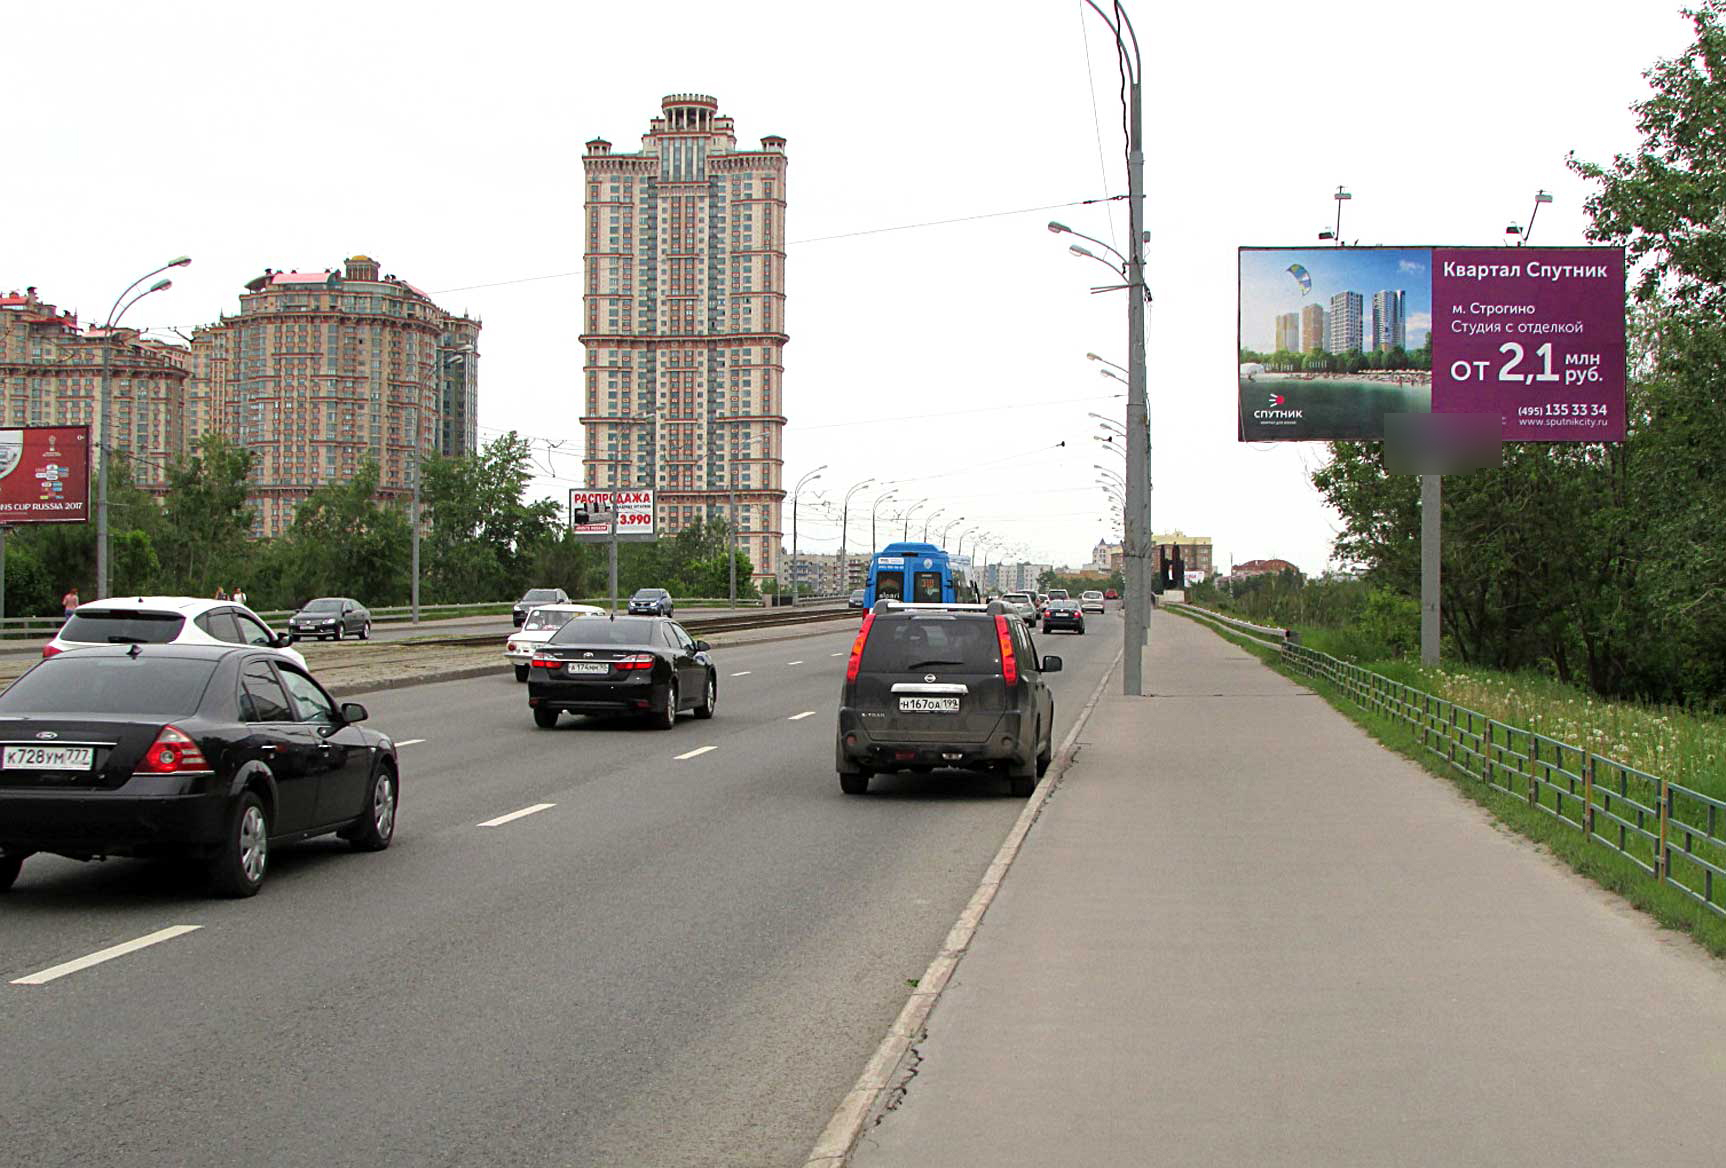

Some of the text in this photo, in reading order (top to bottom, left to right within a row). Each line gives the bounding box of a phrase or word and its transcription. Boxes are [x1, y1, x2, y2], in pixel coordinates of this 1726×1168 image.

[1443, 261, 1608, 280] Квартал Спутник
[1452, 302, 1536, 317] м. Строгино
[1451, 319, 1583, 335] Студия с отделкой
[1450, 342, 1560, 385] от 2,1
[1565, 354, 1601, 366] млн
[1565, 367, 1604, 384] руб.
[1253, 410, 1304, 419] СПУТНИК
[1518, 403, 1608, 417] (495) 135 33 34
[1518, 417, 1608, 428] www.sputnikcity.ru
[32, 502, 63, 510] RUSSIA
[65, 502, 83, 510] 2017
[619, 514, 651, 525] 3.990
